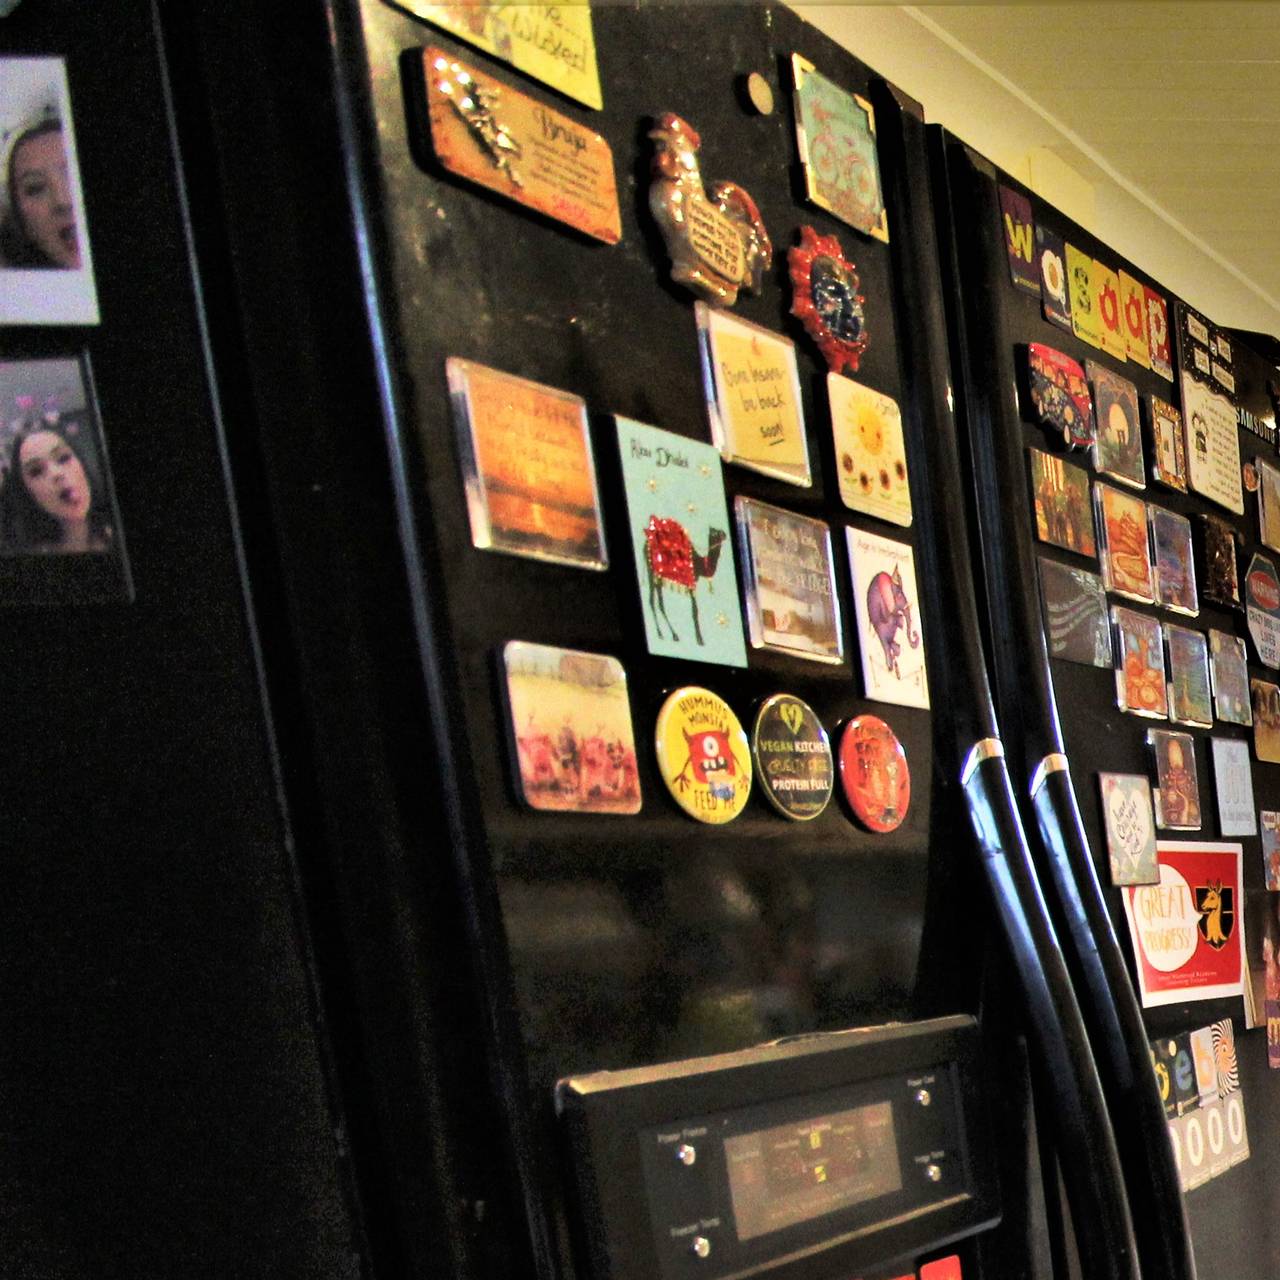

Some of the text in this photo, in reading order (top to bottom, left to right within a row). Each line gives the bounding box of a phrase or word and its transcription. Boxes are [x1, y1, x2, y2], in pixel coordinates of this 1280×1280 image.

[760, 740, 793, 753] VEGAN
[772, 777, 830, 791] PROTEIN FULL
[1139, 885, 1187, 921] GREAT
[1143, 926, 1193, 953] PROGRESS!
